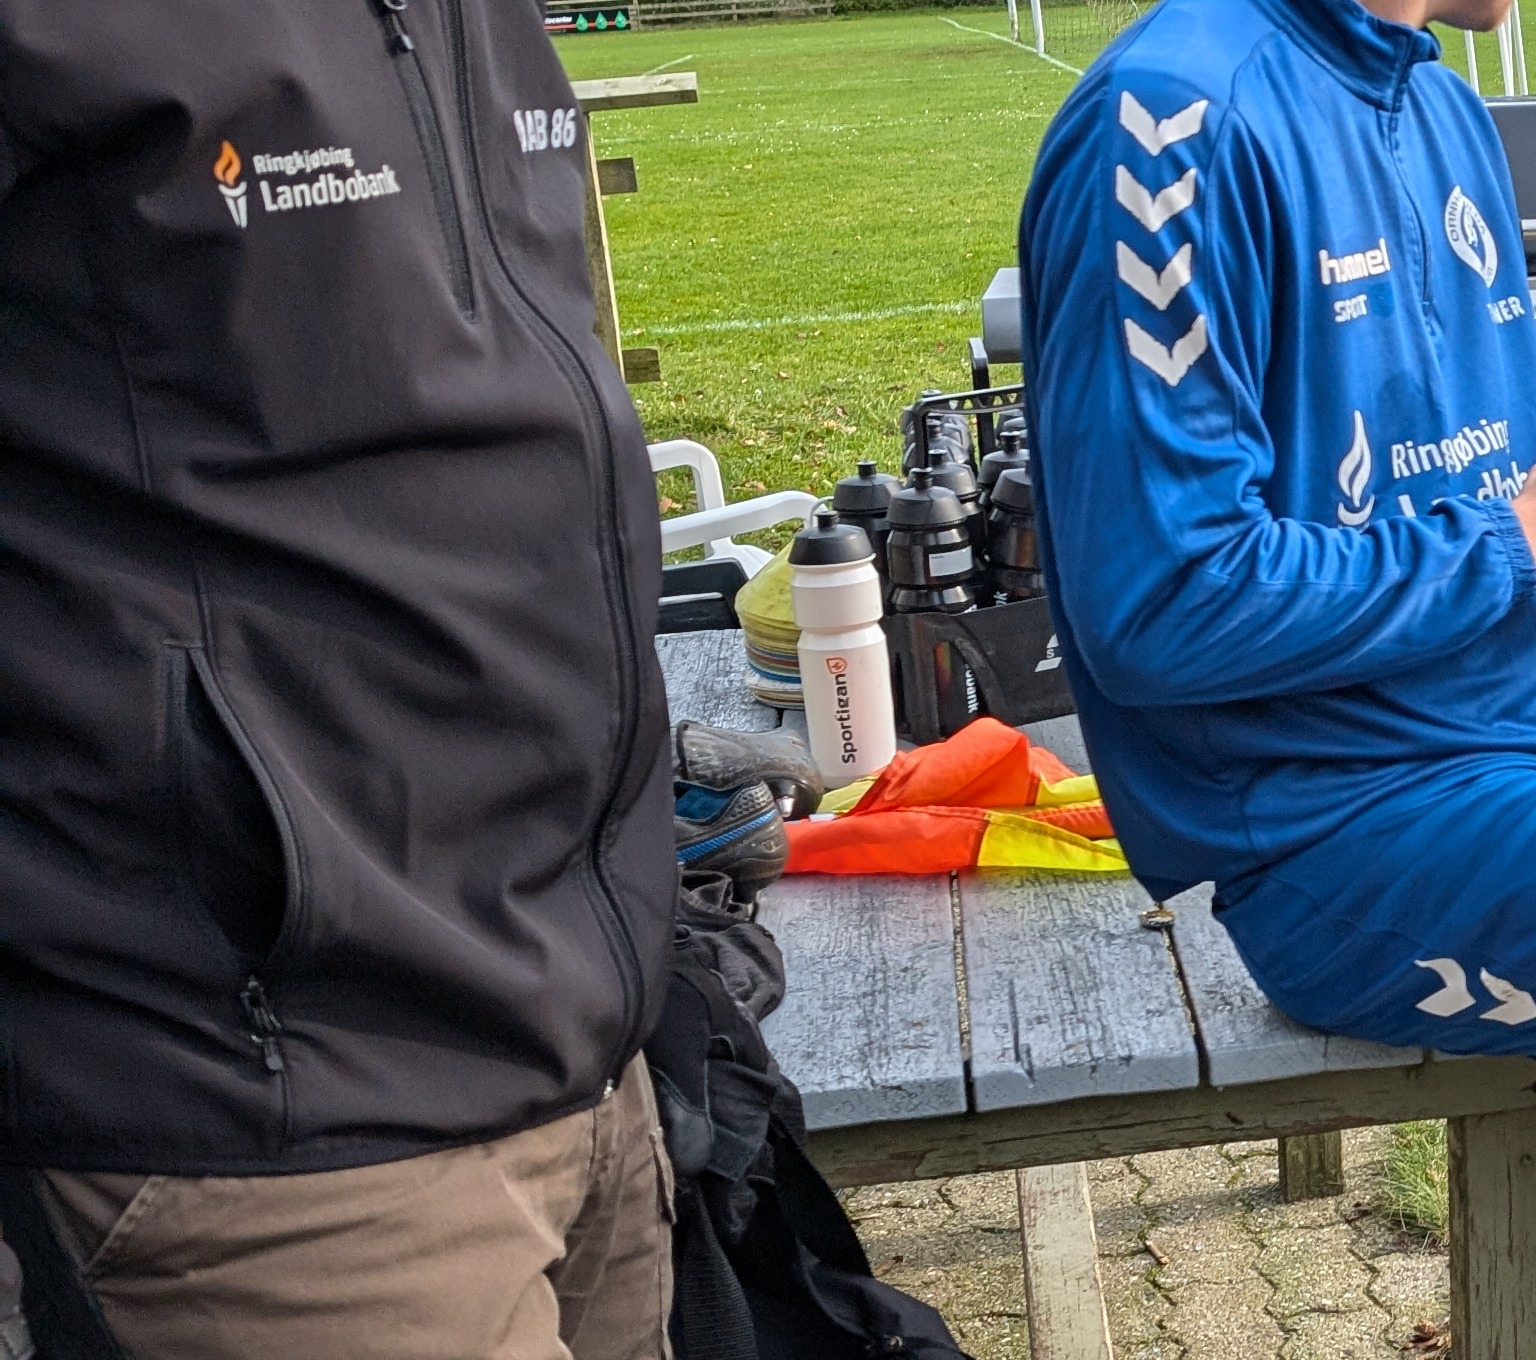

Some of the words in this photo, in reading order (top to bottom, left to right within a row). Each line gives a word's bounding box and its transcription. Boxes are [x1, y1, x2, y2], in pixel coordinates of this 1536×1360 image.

[550, 107, 577, 149] 86
[252, 146, 355, 175] Ringkjøbing
[259, 164, 402, 212] Landbobank
[833, 672, 858, 764] Sportigan
